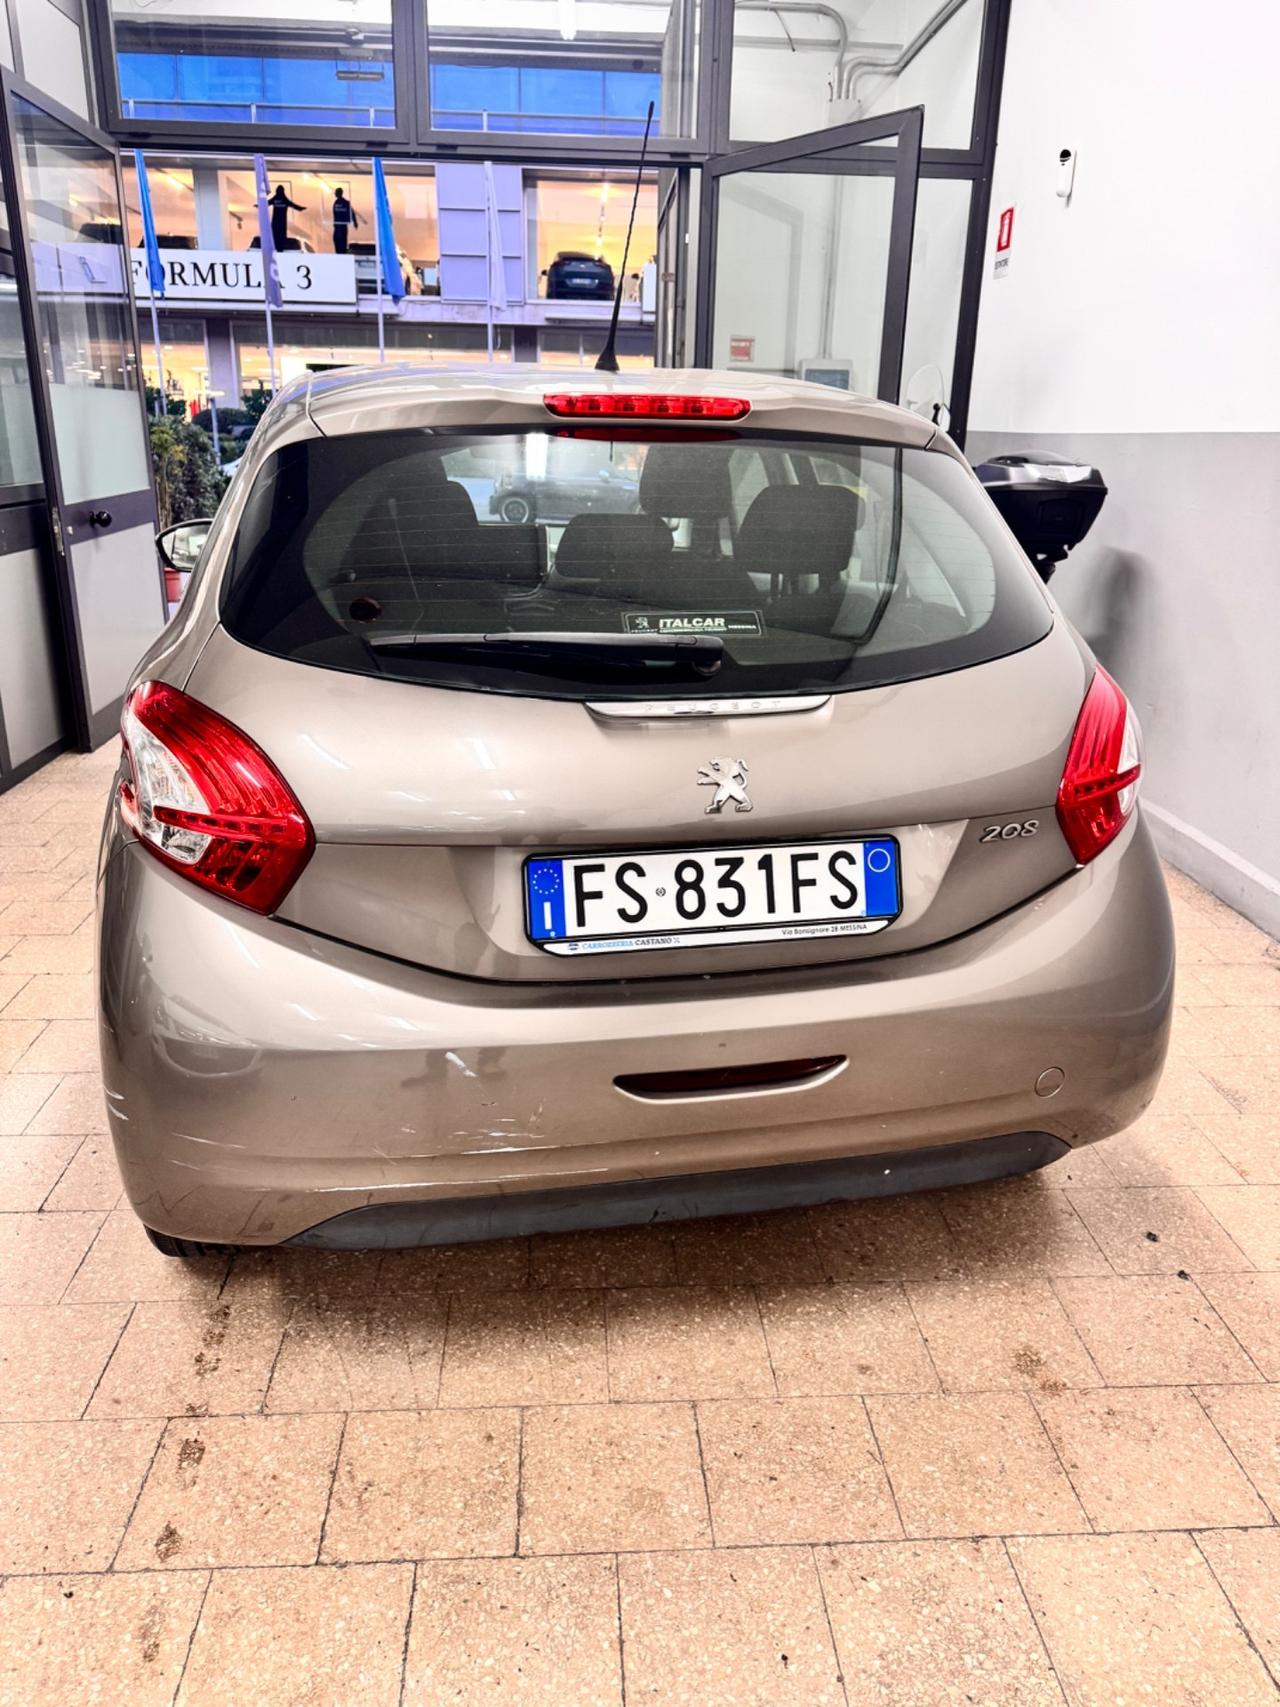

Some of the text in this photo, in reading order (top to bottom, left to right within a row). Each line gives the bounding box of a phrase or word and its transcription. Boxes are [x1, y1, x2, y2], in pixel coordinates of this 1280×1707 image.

[130, 260, 312, 290] FRMUL 3
[659, 617, 725, 628] ITALCAR
[980, 818, 1039, 843] 208
[635, 937, 672, 947] CASTANO
